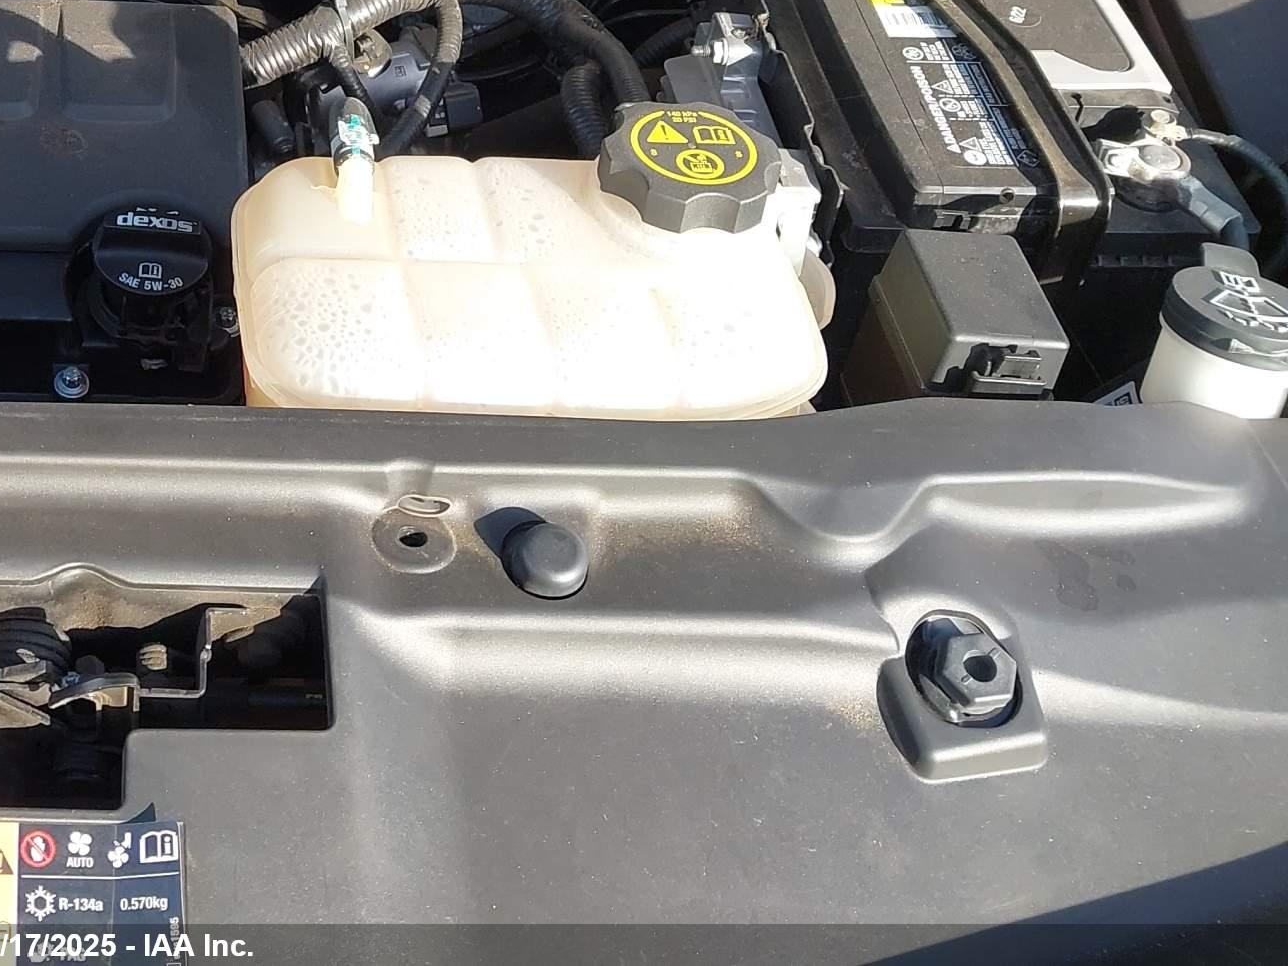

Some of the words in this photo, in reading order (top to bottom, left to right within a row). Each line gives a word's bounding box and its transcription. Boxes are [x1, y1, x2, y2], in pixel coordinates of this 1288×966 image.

[116, 211, 194, 233] dexos
[118, 272, 141, 289] SAE
[143, 276, 184, 291] 5W-30
[66, 857, 94, 869] AUTO
[58, 897, 104, 912] R-134a
[120, 897, 169, 912] 0.570kg
